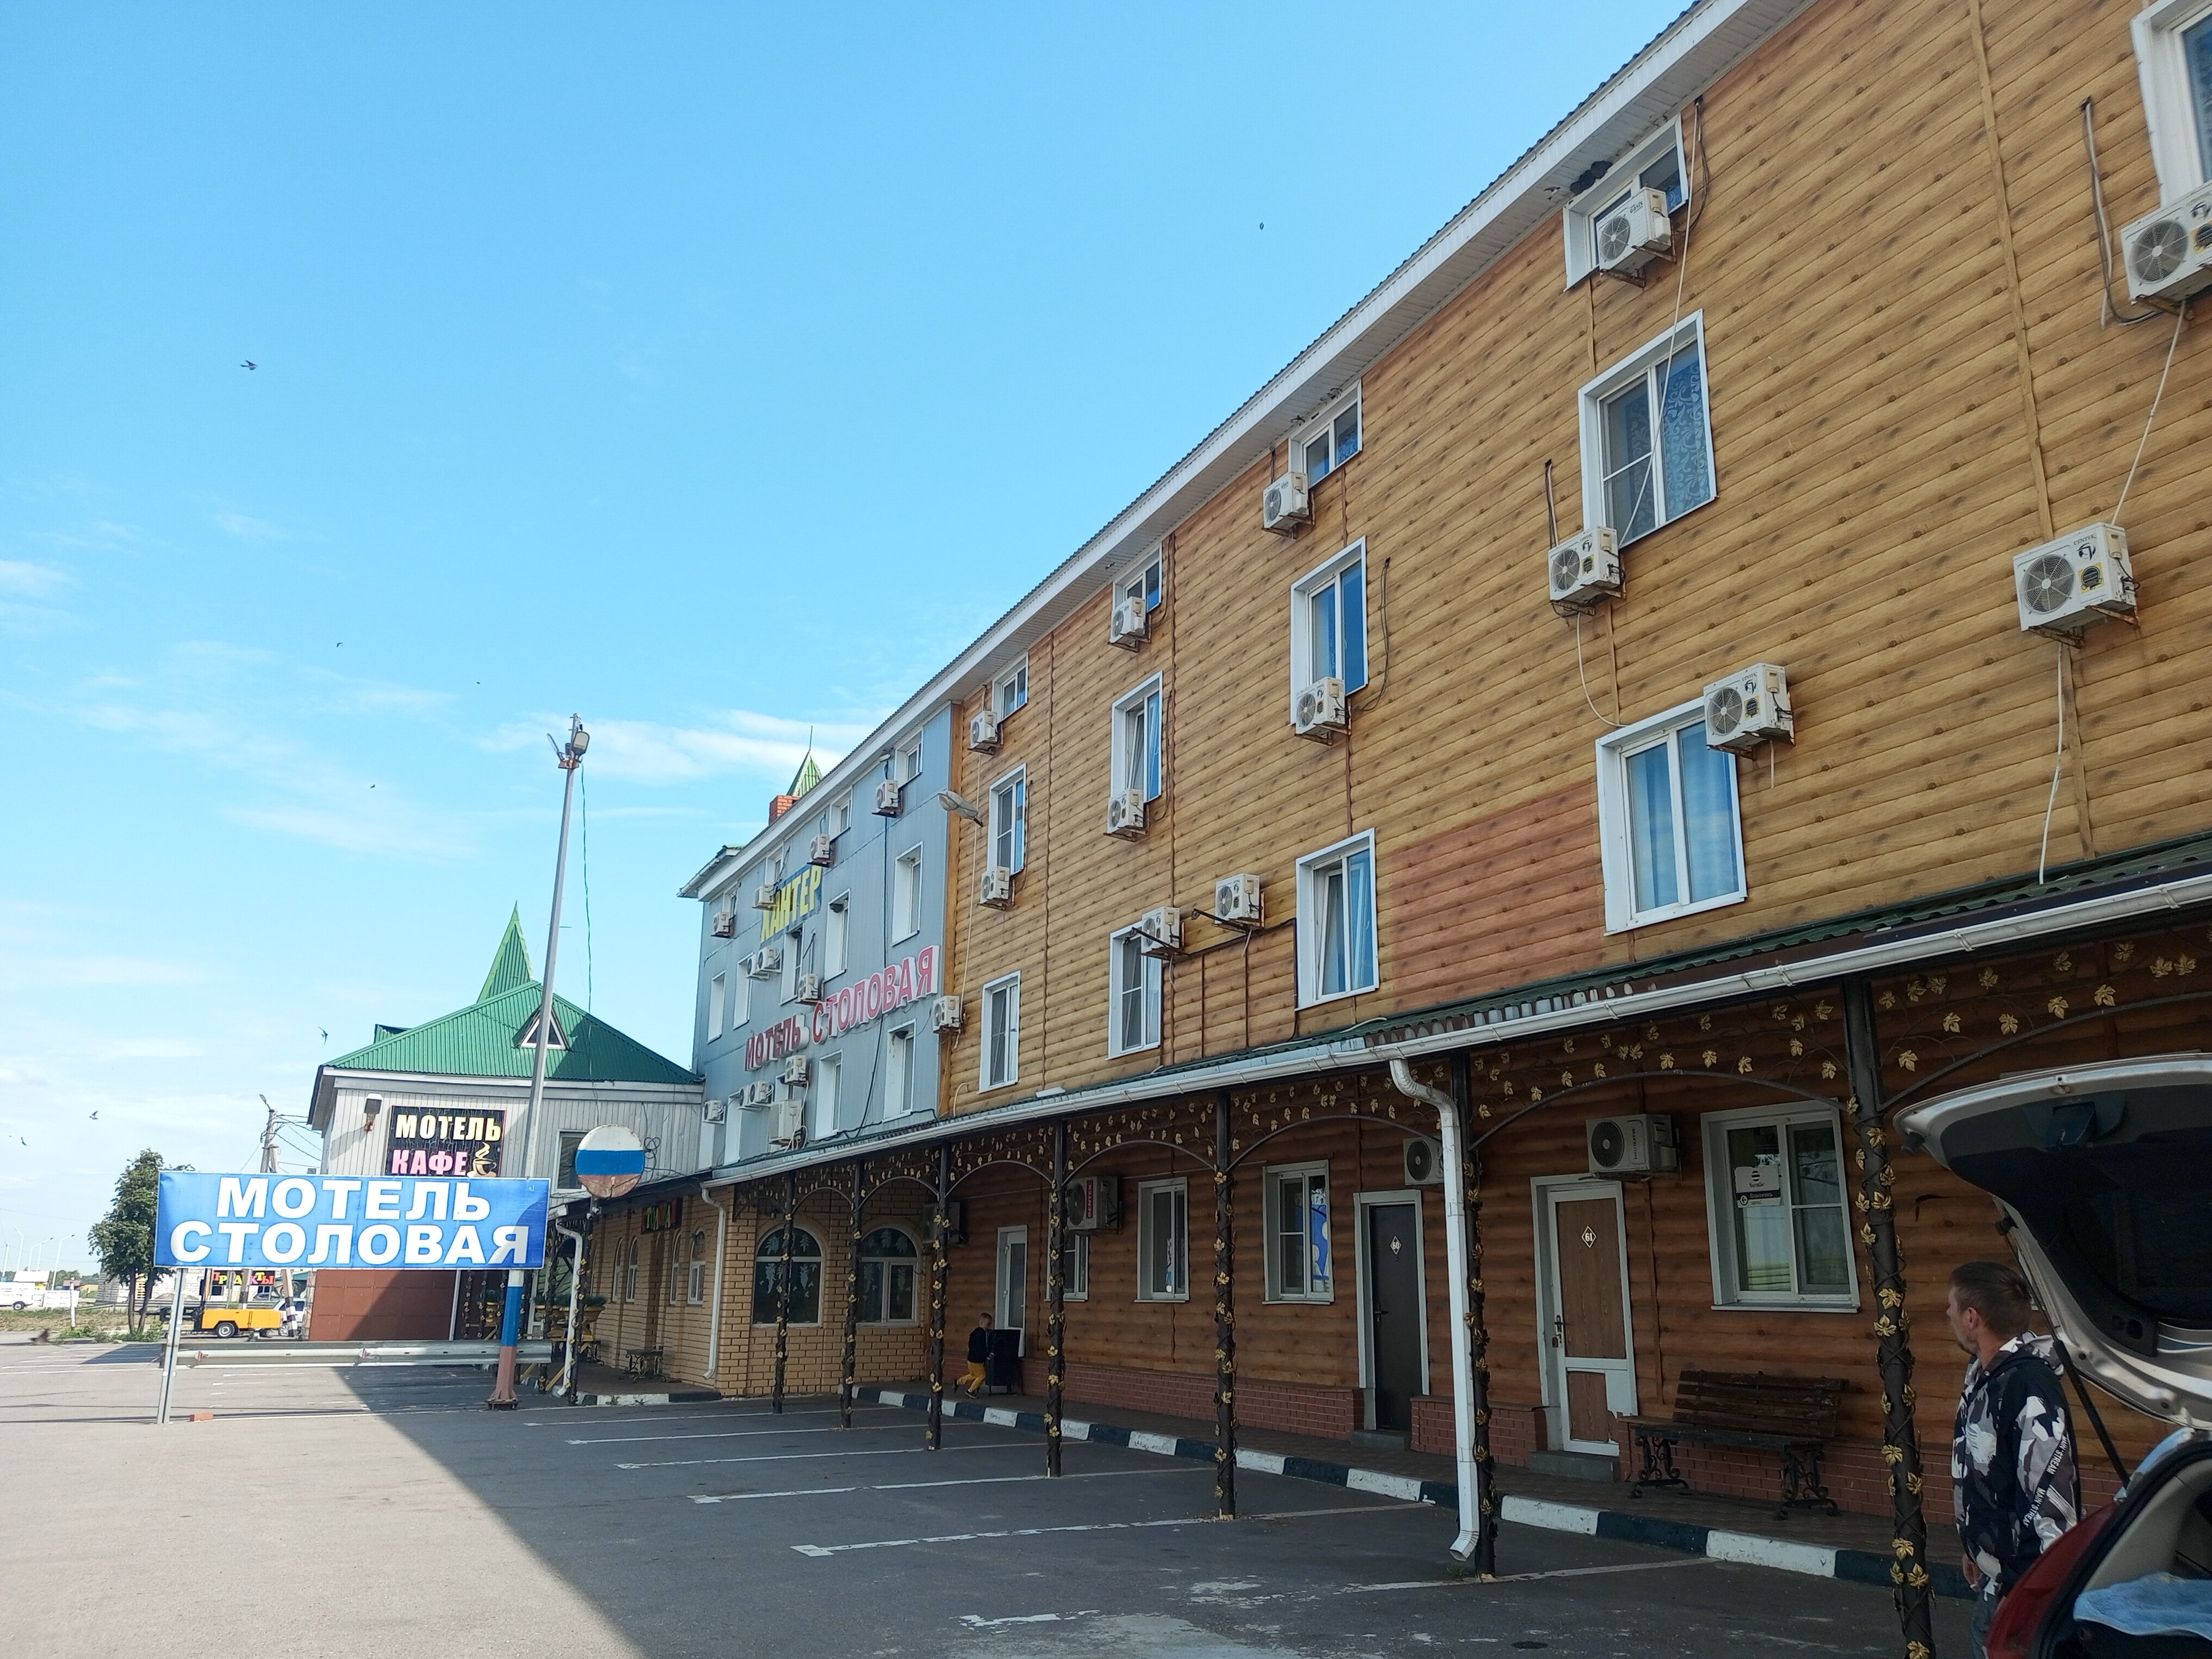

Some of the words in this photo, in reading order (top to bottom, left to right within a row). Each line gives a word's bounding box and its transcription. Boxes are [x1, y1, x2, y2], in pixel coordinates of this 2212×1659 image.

[745, 1013, 809, 1072] МОТЕЛЬ
[812, 945, 939, 1045] СТОЛОВАЯ
[395, 1114, 501, 1141] МОТЕЛЬ
[391, 1149, 468, 1176] КАФЕ
[216, 1177, 490, 1221] МОТЕЛЬ
[170, 1220, 530, 1265] СТОЛОВАЯ
[1393, 1242, 1399, 1250] 60
[1585, 1232, 1593, 1242] 61
[213, 1271, 274, 1285] ПРДКТЫ
